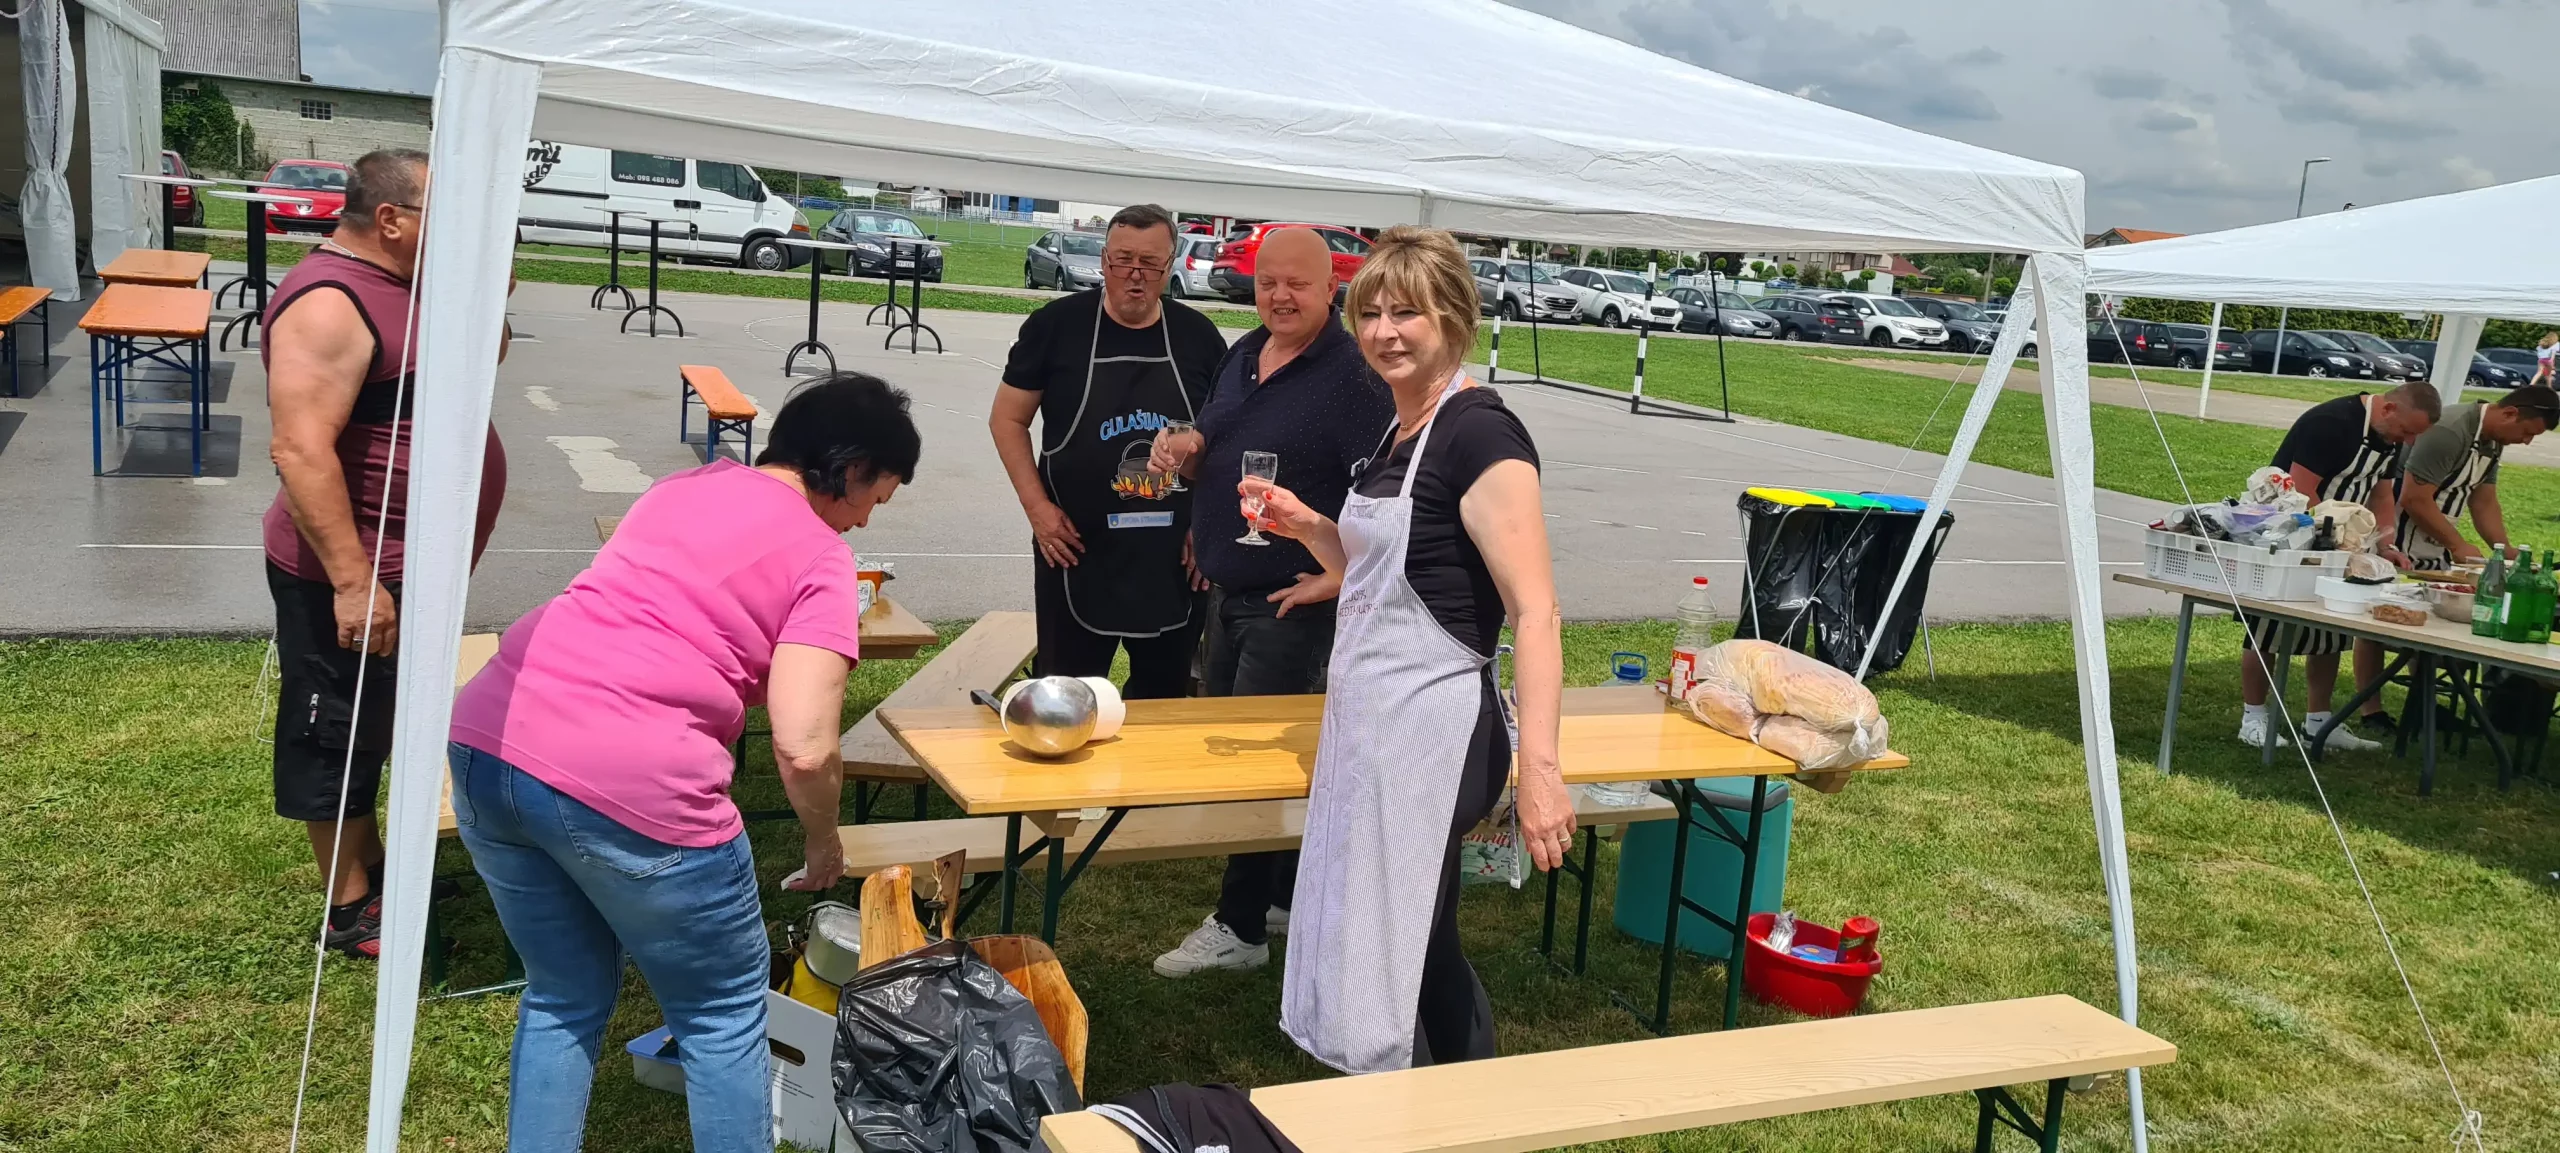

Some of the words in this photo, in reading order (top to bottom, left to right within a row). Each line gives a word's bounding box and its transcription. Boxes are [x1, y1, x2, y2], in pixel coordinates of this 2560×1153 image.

[618, 173, 636, 181] Mob:
[666, 177, 680, 185] 086
[1100, 409, 1169, 440] GULAŠIJAD
